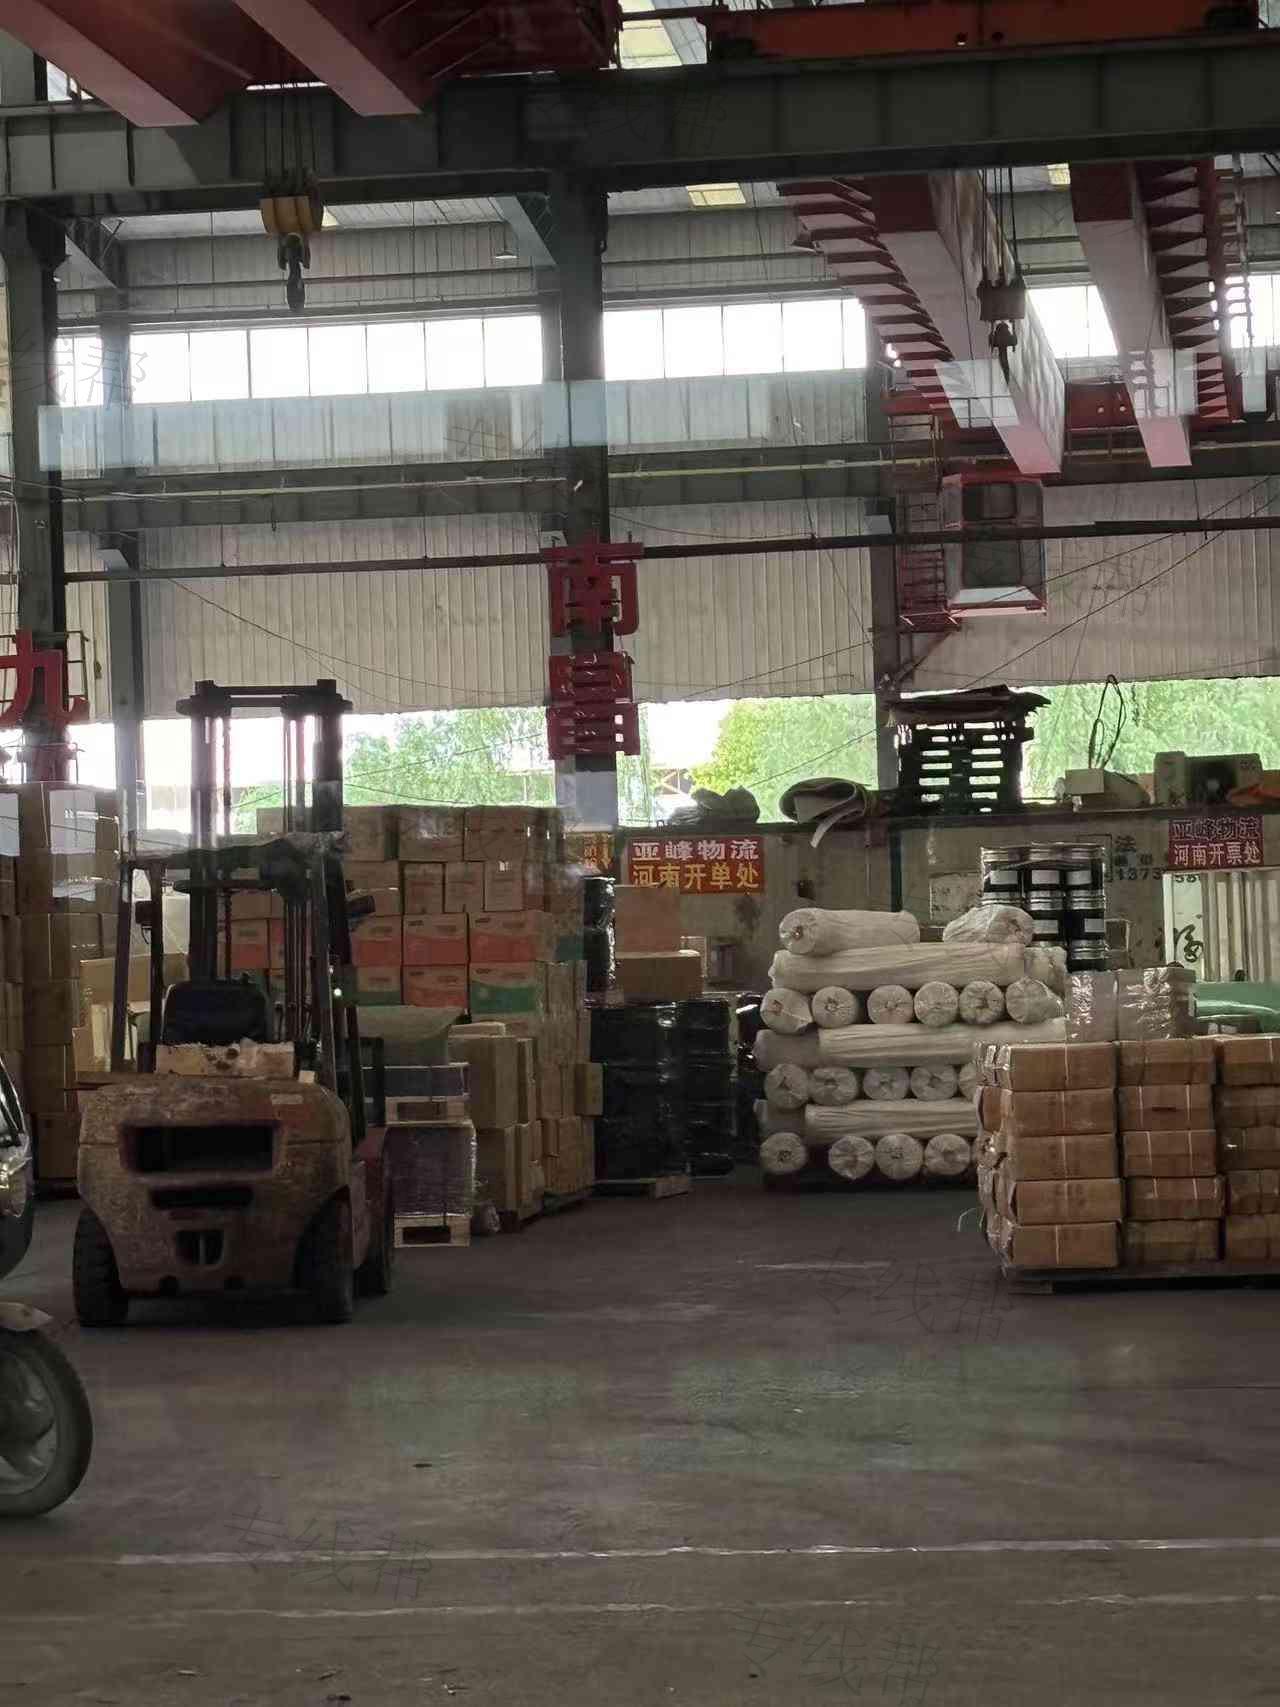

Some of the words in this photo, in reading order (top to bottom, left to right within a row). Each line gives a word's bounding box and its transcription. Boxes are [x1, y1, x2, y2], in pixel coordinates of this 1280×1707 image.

[632, 840, 760, 861] 亚峰物流
[1174, 840, 1261, 867] 河南开票处
[632, 863, 760, 890] 河南开单处
